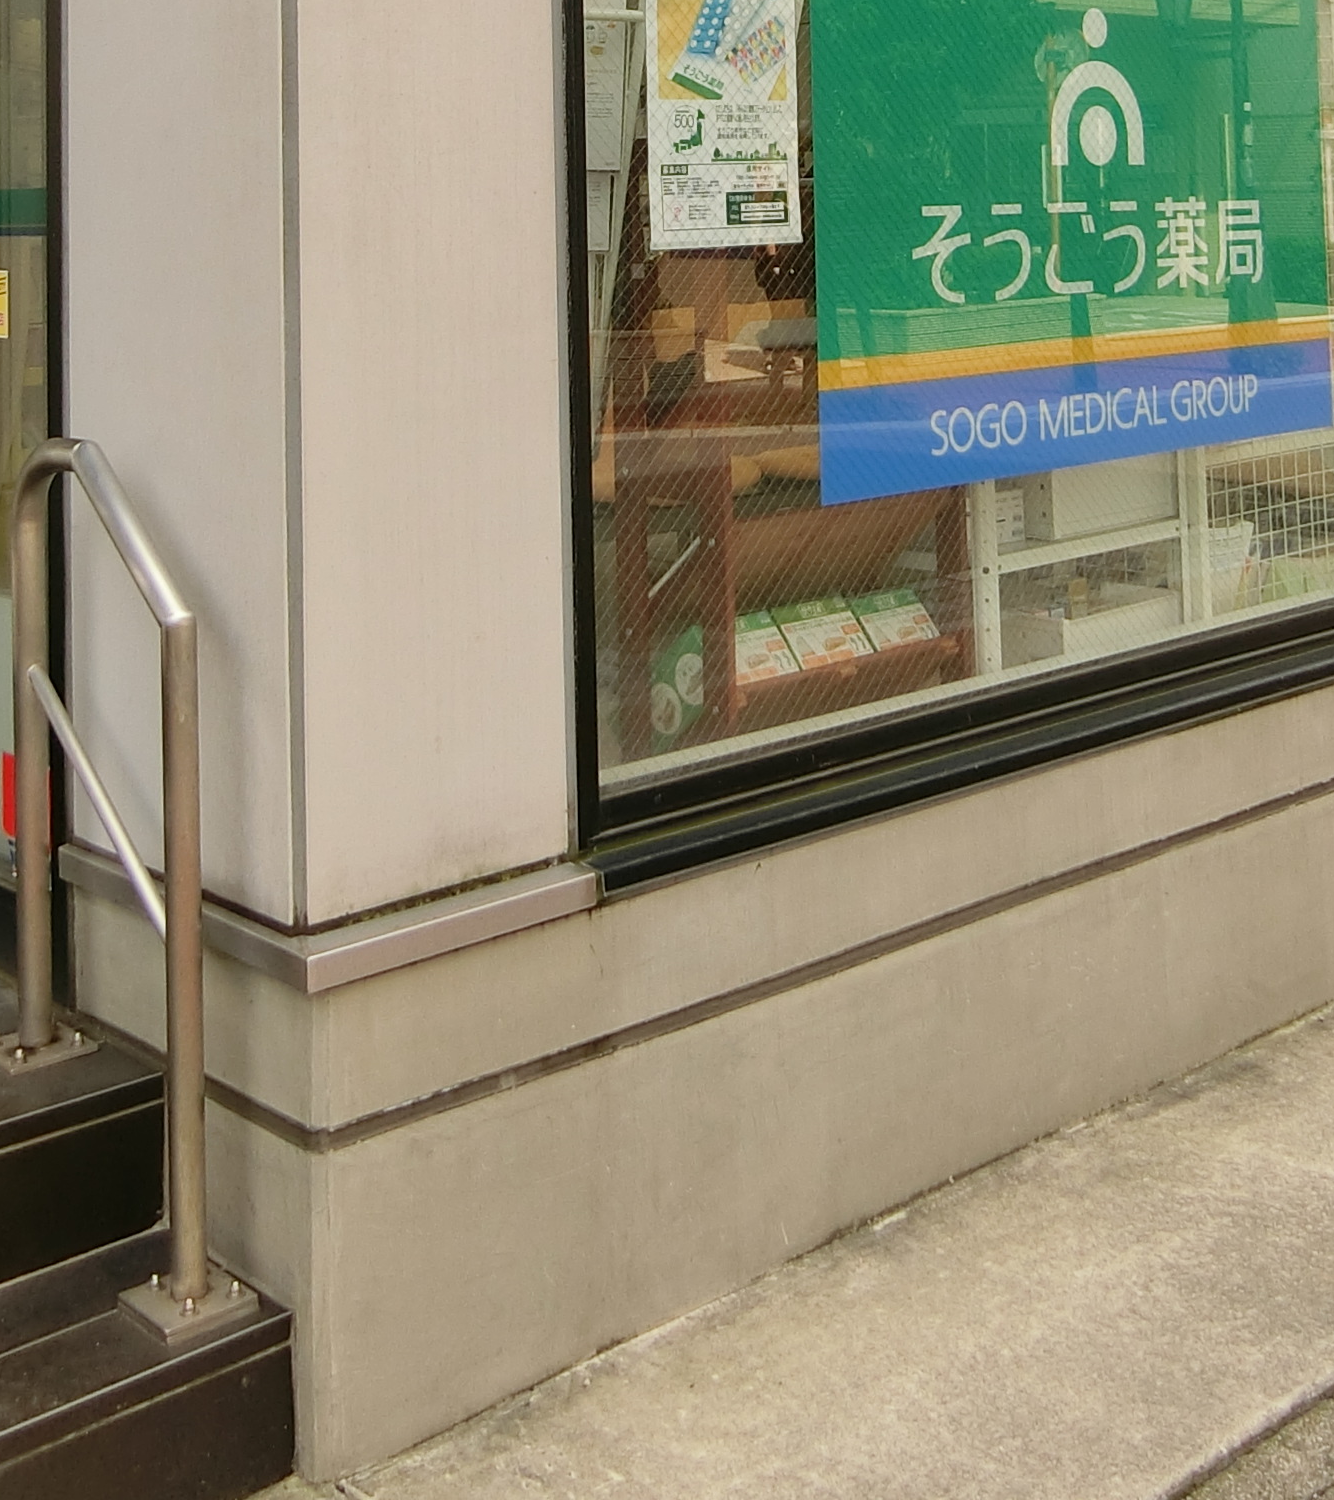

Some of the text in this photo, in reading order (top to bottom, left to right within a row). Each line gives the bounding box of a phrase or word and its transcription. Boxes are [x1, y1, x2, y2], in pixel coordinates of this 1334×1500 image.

[911, 195, 1265, 305] そうごう薬局
[930, 373, 1259, 457] SOGO MEDICAL GROUP
